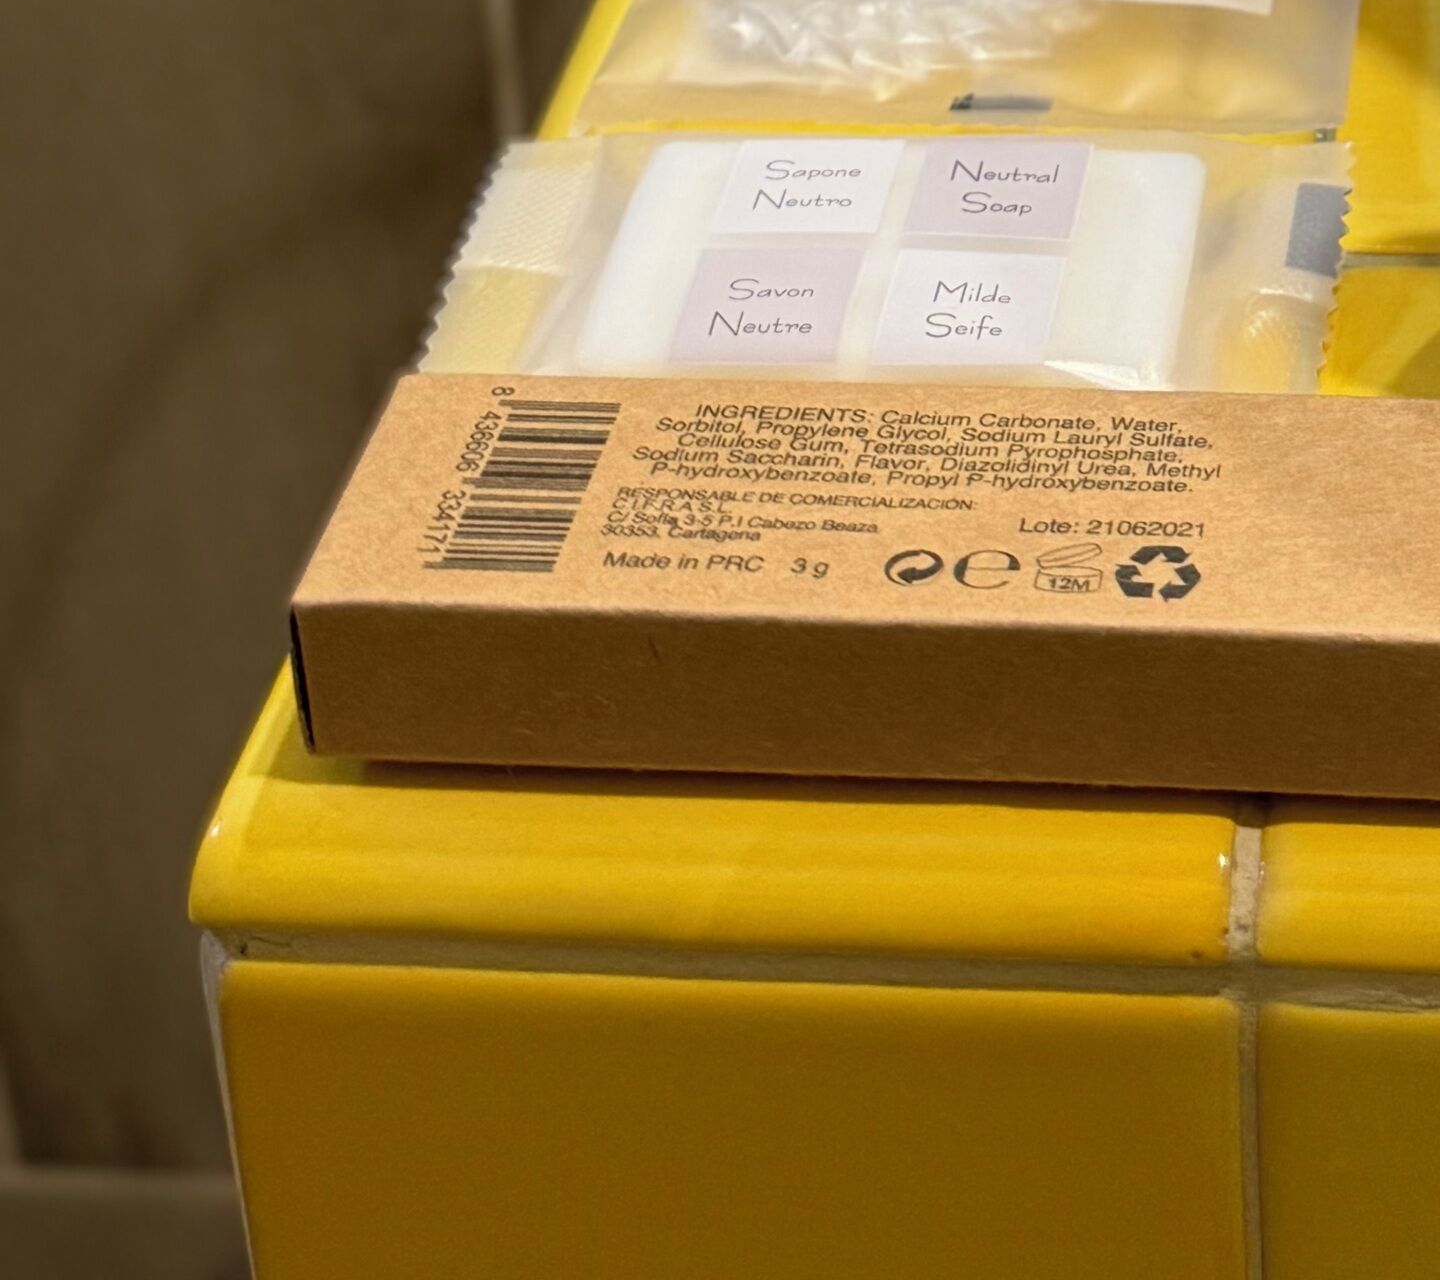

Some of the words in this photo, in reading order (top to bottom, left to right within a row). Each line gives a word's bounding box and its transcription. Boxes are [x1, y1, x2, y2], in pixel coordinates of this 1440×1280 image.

[765, 159, 862, 181] Sapone
[950, 159, 1060, 183] Neutral
[752, 188, 852, 210] Neutro
[961, 191, 1033, 216] Soap
[728, 278, 815, 301] Savon
[933, 280, 1012, 304] Milde
[708, 310, 813, 336] Neutre
[925, 312, 1003, 340] Seife
[491, 386, 516, 397] 8
[695, 403, 875, 424] INGREDIENTS:
[881, 409, 971, 427] Calcium
[979, 413, 1100, 431] Carbonate,
[1111, 416, 1183, 434] Water,
[656, 417, 746, 435] Sorbitol,
[756, 421, 869, 440] Propylene
[877, 424, 952, 443] Glycol,
[961, 427, 1045, 443] Sodium
[1053, 430, 1122, 448] Lauryl
[1129, 433, 1213, 450] Sulfate,
[677, 433, 781, 450] Cellulose
[790, 437, 848, 454] Gum,
[861, 439, 999, 457] Tetrasodium
[1007, 443, 1183, 463] Pyrophosphate,
[632, 446, 718, 463] Sodium
[726, 449, 844, 468] Saccharin,
[855, 454, 930, 472] Flavor,
[940, 457, 1069, 476] Diazolidinyl
[1077, 460, 1137, 478] Urea,
[1146, 463, 1221, 481] Methyl
[650, 461, 876, 486] P-hydroxybenzoate,
[886, 471, 959, 489] Propyl
[966, 472, 1193, 493] P-hydroxybenzoate.
[617, 486, 756, 502] RESPONSABLE
[759, 492, 784, 504] DE
[667, 525, 761, 542] Cartagena
[747, 515, 816, 530] Cabezo
[821, 518, 879, 533] Beaza
[1019, 517, 1079, 534] Lote:
[1086, 519, 1204, 538] 21062021
[603, 551, 672, 570] Made
[678, 553, 699, 571] in
[706, 554, 765, 572] PRC
[790, 557, 807, 575] 3
[812, 561, 830, 579] g
[1048, 577, 1090, 591] 12M
